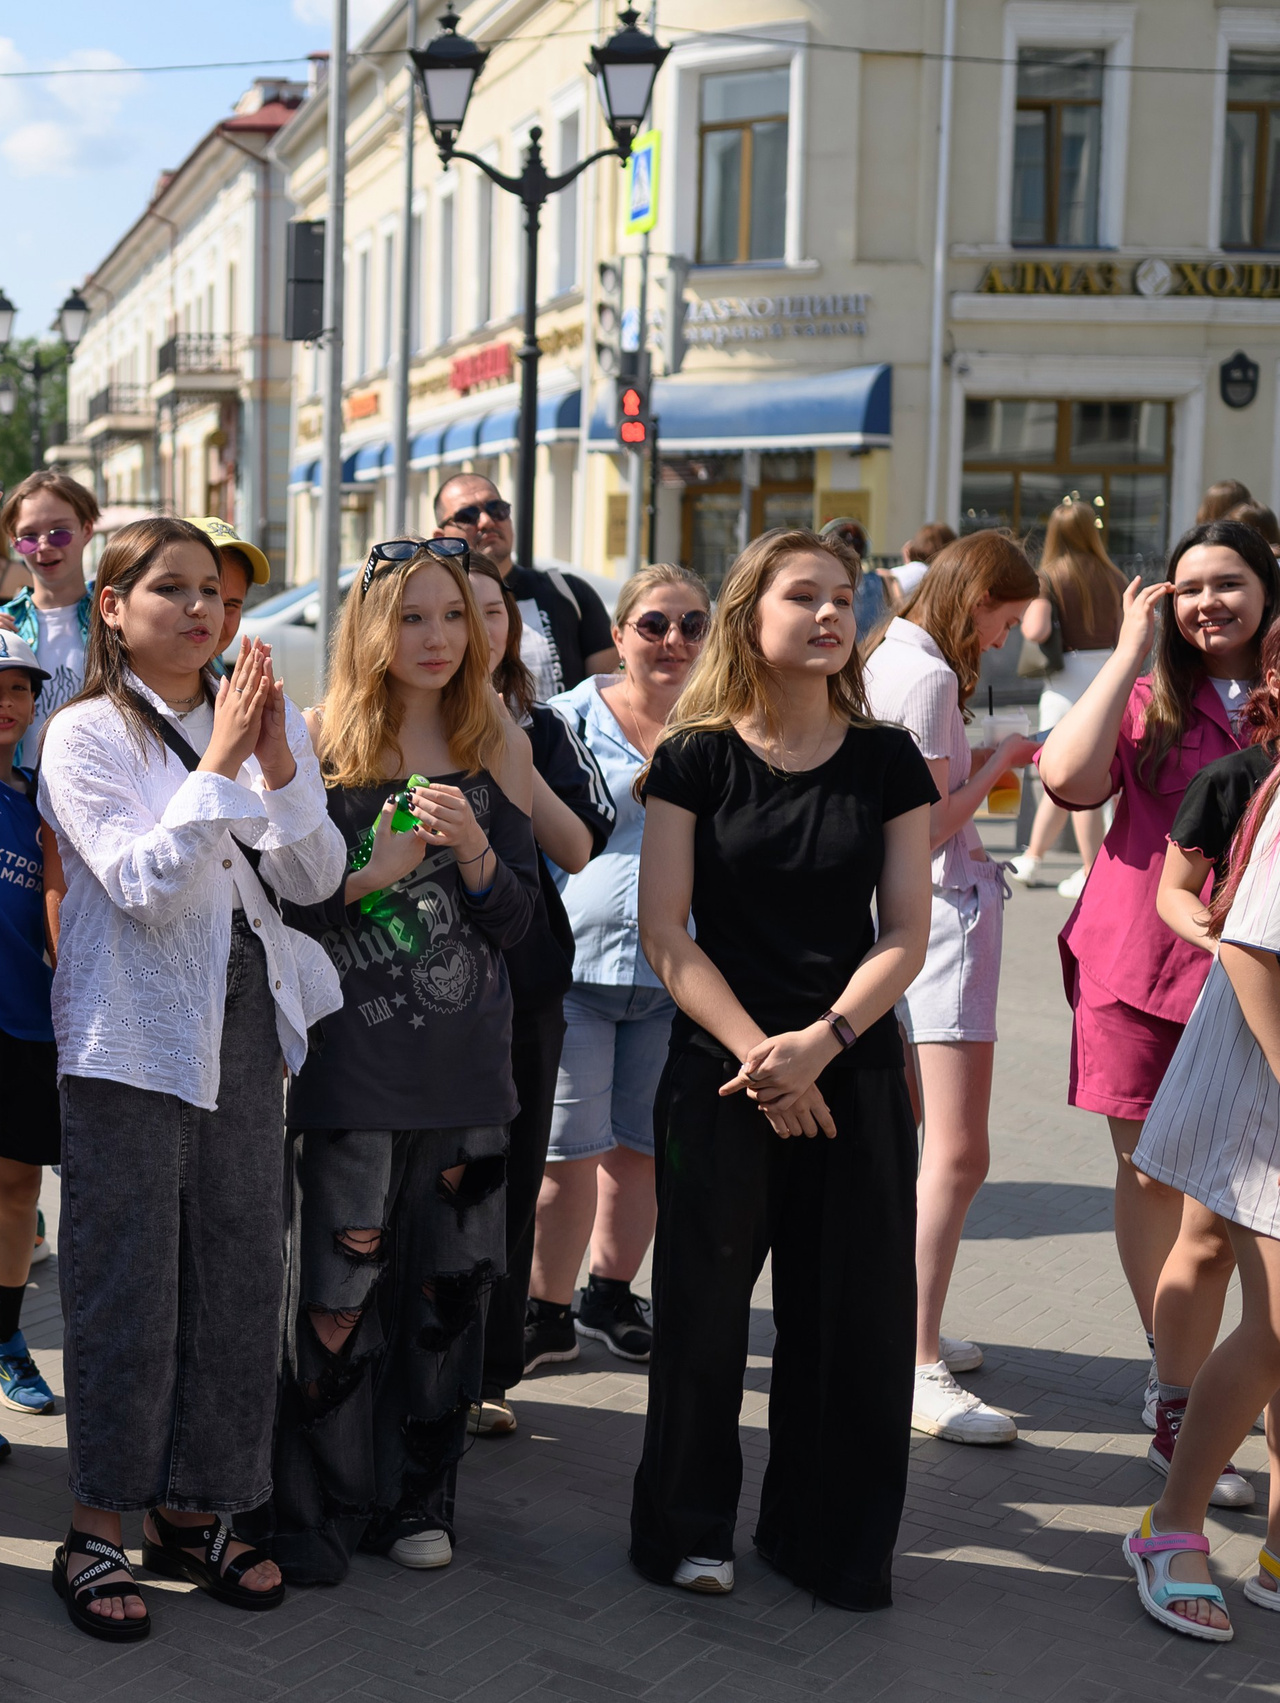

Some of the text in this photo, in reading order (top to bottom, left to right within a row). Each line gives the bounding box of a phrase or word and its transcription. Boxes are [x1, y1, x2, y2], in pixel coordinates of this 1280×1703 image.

[980, 261, 1121, 294] АЛМАЗ
[357, 996, 395, 1027] YEAR
[73, 1560, 116, 1587] GAODENP
